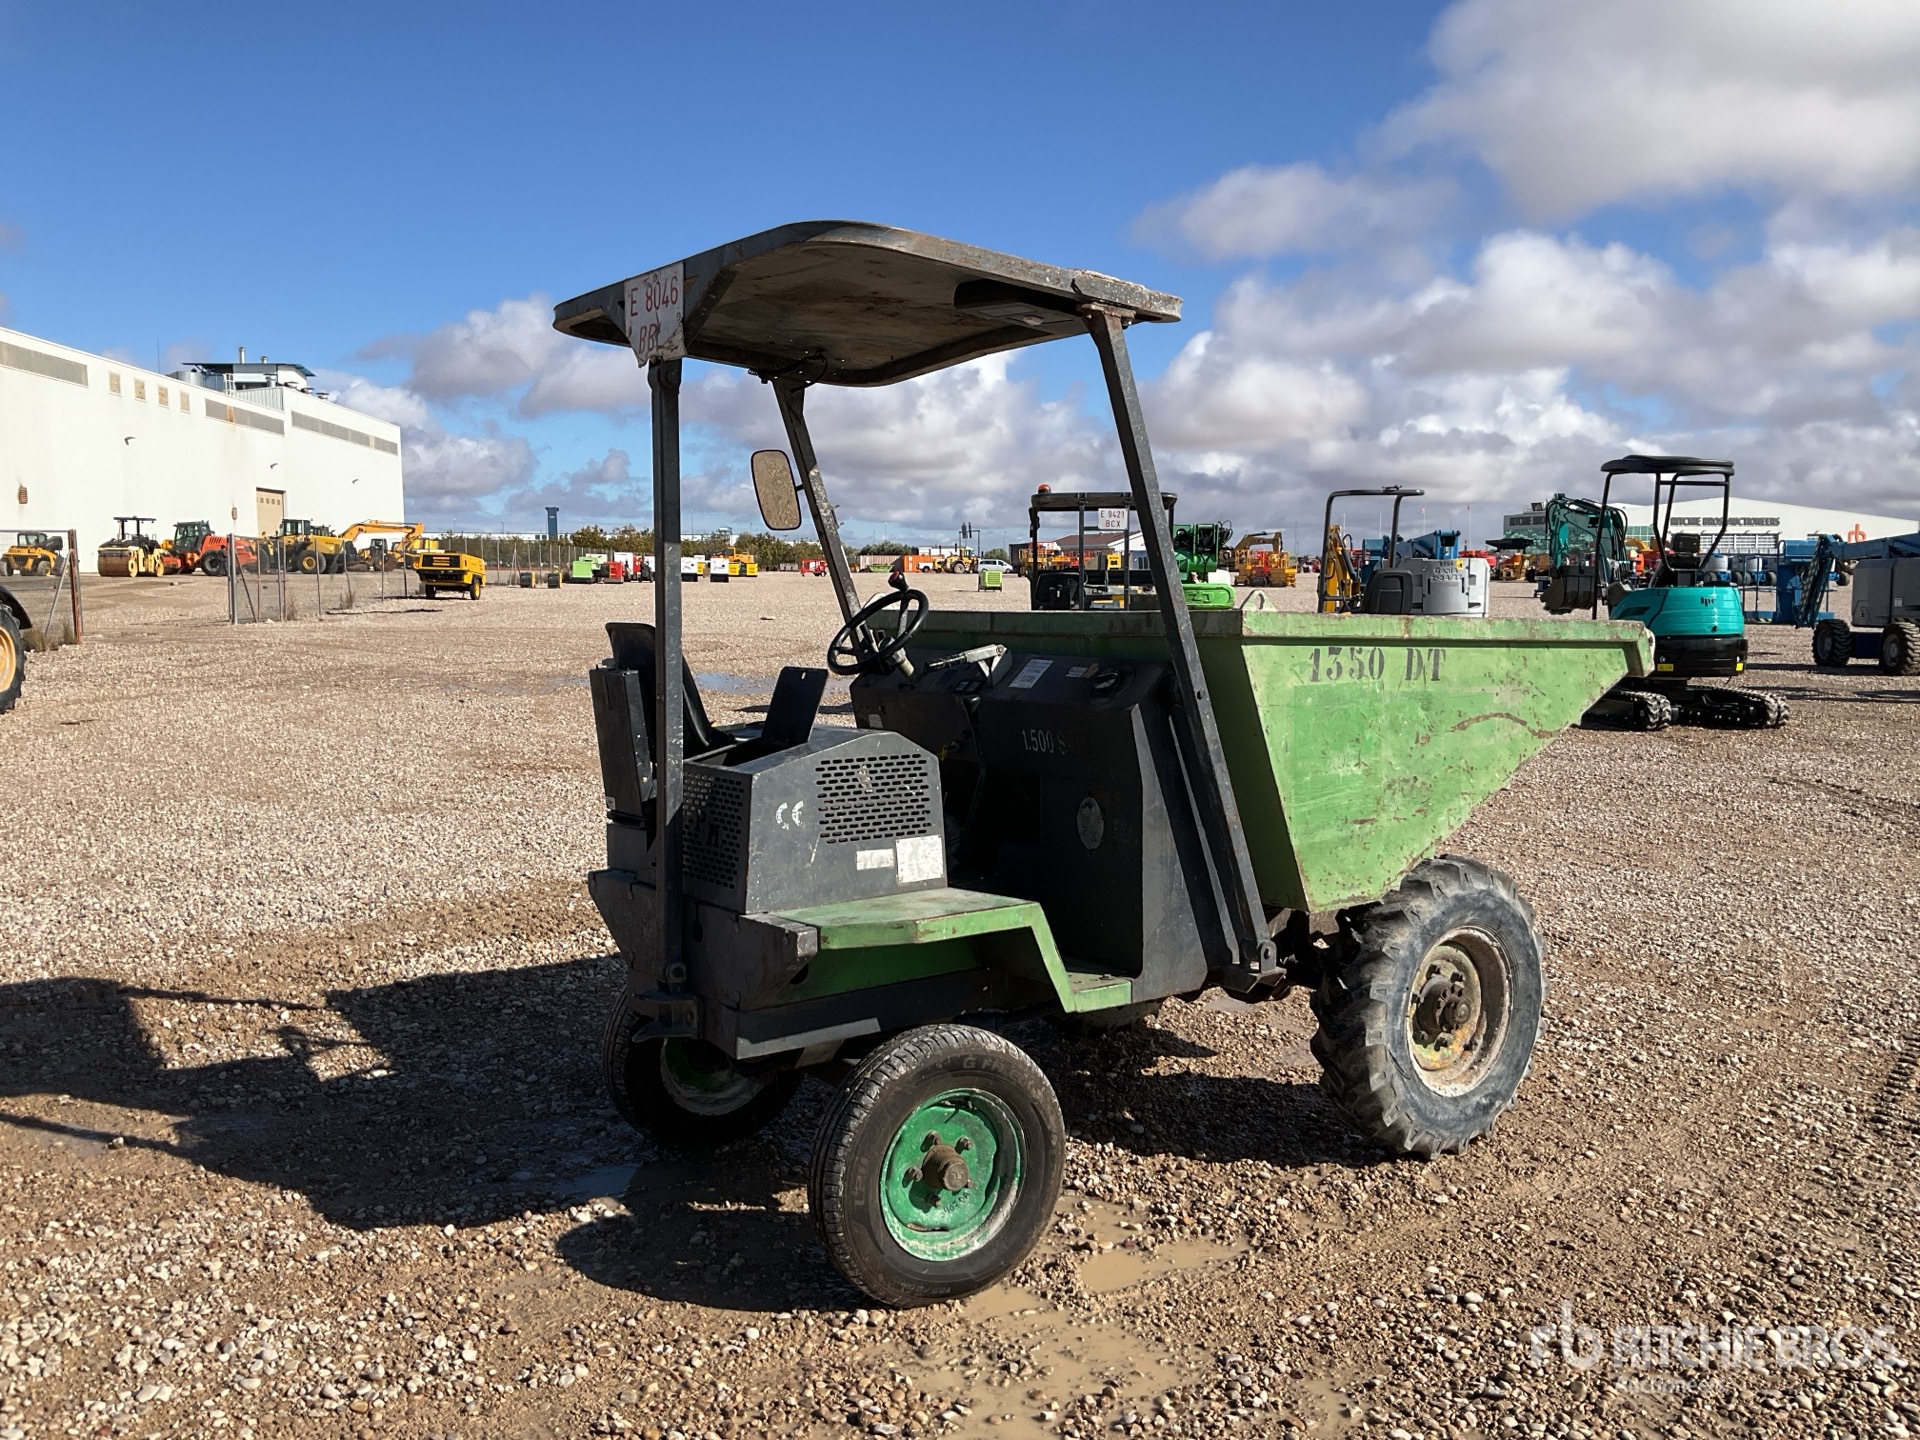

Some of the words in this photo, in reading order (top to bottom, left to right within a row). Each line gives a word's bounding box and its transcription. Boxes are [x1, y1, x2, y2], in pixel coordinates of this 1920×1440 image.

[631, 288, 638, 317] E
[646, 276, 678, 312] 8046
[1105, 519, 1121, 528] BCX
[1108, 509, 1125, 518] 9421
[1309, 646, 1385, 683] 1350
[1404, 647, 1447, 682] DT
[1021, 728, 1055, 754] 1.500
